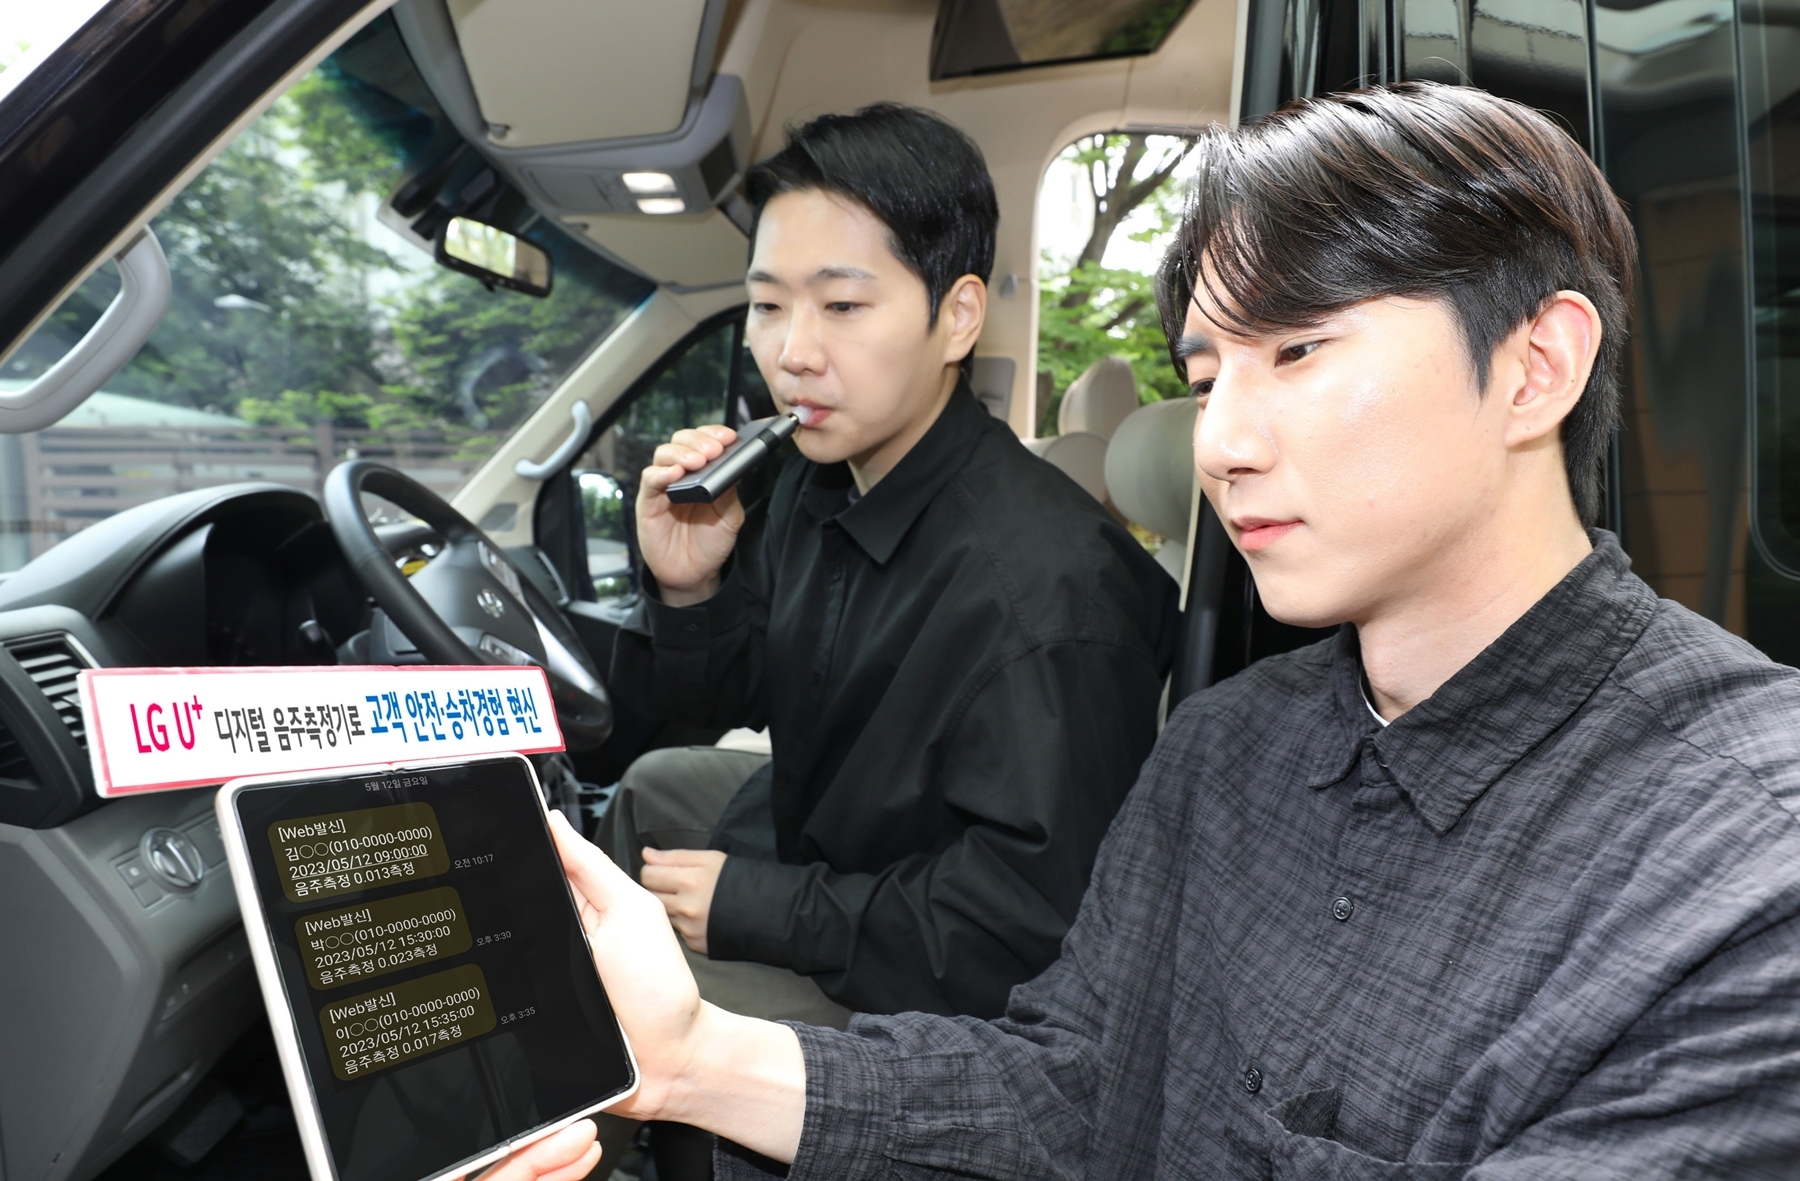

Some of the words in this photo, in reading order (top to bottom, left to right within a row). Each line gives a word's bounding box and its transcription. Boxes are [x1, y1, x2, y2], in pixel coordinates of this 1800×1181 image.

[130, 703, 170, 753] LG
[172, 695, 203, 750] U+
[214, 707, 271, 753] 디지털
[273, 703, 365, 751] 음주측정기로
[365, 694, 407, 743] 고객
[508, 686, 542, 734] 혁신
[364, 781, 380, 792] 5월
[381, 779, 401, 790] 12일
[403, 776, 428, 788] 금요일
[278, 819, 346, 842] [Web발신]
[290, 854, 372, 880] 2023/05/12
[375, 844, 428, 864] 09:00:00
[454, 857, 471, 869] 오전
[472, 854, 494, 866] 10:17
[295, 874, 351, 897] 음주측정
[353, 862, 415, 885] 0.013측정
[304, 909, 372, 935] [Web발신]
[477, 935, 493, 946] 오후
[494, 931, 512, 942] 3:30
[315, 938, 396, 969] 2023/05/12
[398, 926, 451, 948] 15:30:00
[320, 959, 375, 985] 음주측정
[378, 943, 438, 969] 0.023측정
[329, 992, 396, 1023] [Web발신]
[501, 1013, 517, 1026] 오후
[517, 1007, 536, 1020] 3:35
[340, 1023, 421, 1058] 2023/05/12
[423, 1005, 475, 1032] 15:35:00
[344, 1047, 400, 1075] 음주측정
[402, 1025, 462, 1054] 0.017측정
